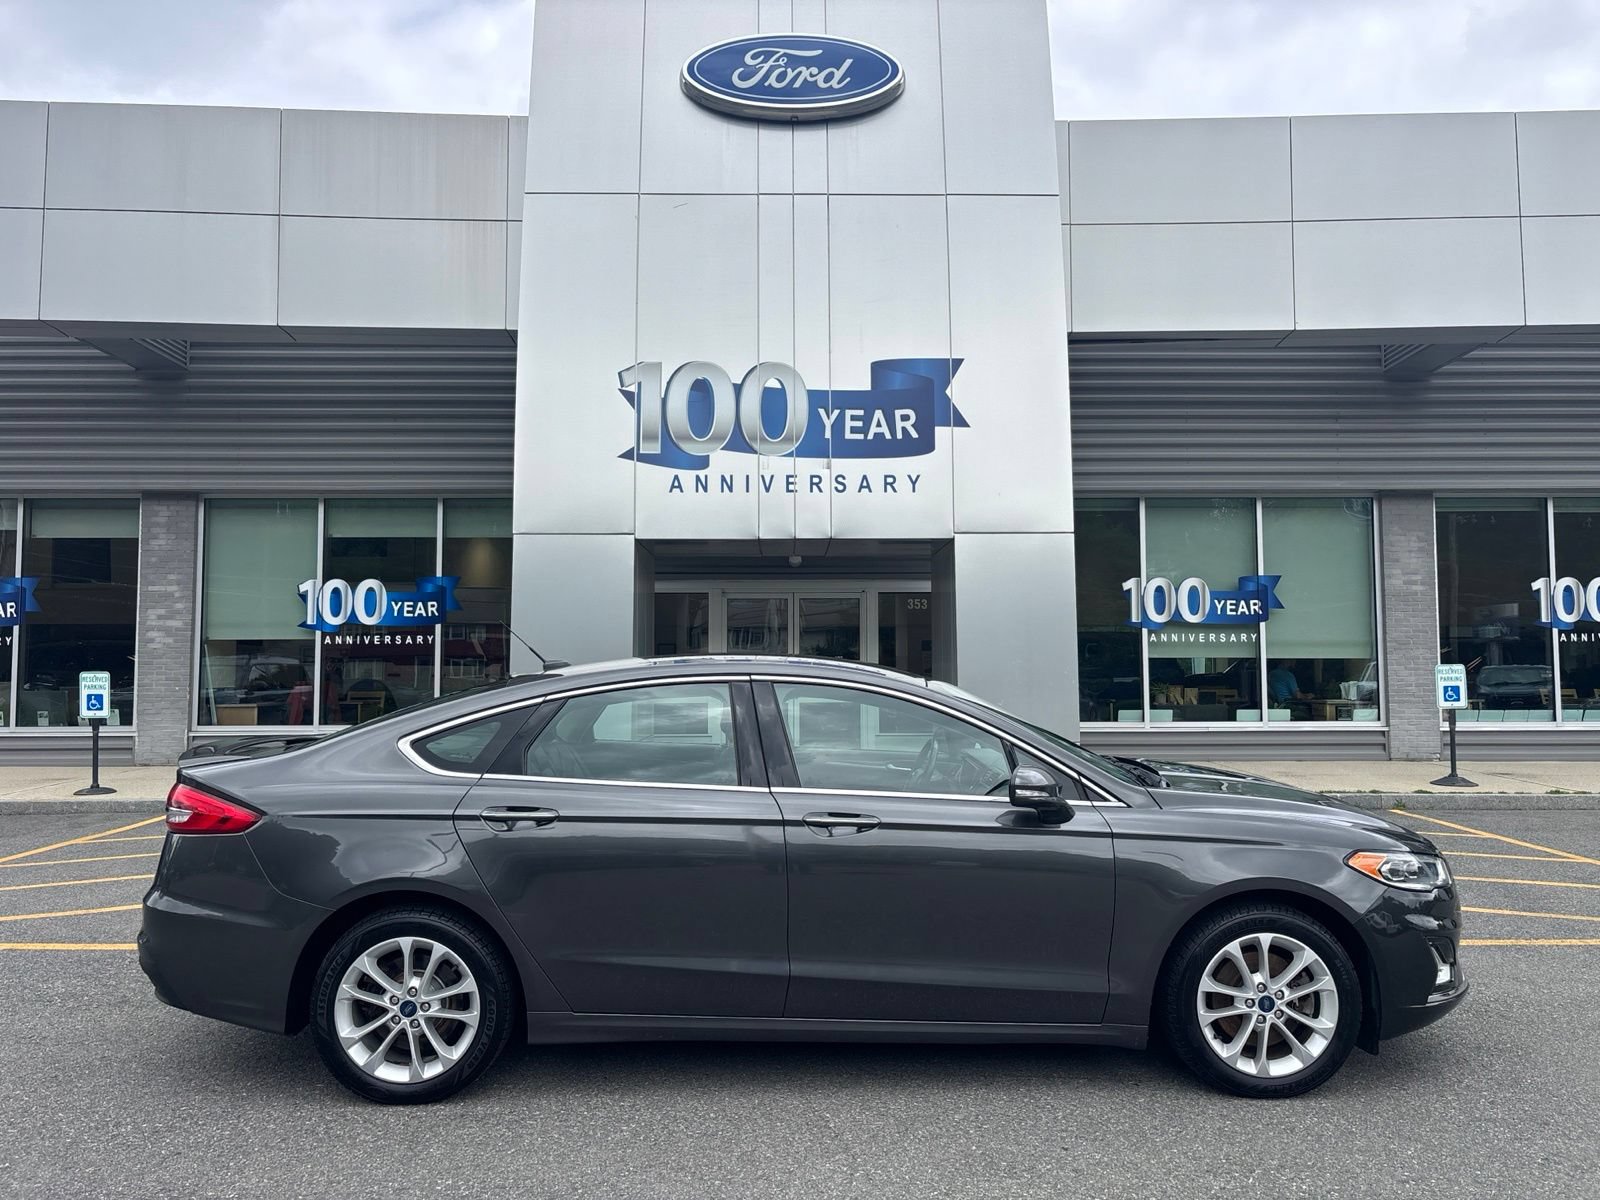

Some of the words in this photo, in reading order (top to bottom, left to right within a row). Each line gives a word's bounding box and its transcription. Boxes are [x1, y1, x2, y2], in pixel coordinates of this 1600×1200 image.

[731, 47, 854, 89] Ford
[617, 360, 809, 456] 100
[817, 408, 919, 441] YEAR
[668, 474, 922, 493] ANNIVERSARY
[298, 578, 388, 625] 100
[391, 601, 439, 617] YEAR
[907, 599, 928, 610] 353
[1122, 577, 1211, 623] 100
[1214, 599, 1263, 615] YEAR
[324, 635, 434, 645] ANNIVERSARY
[1150, 633, 1257, 643] ANNIVERSARY
